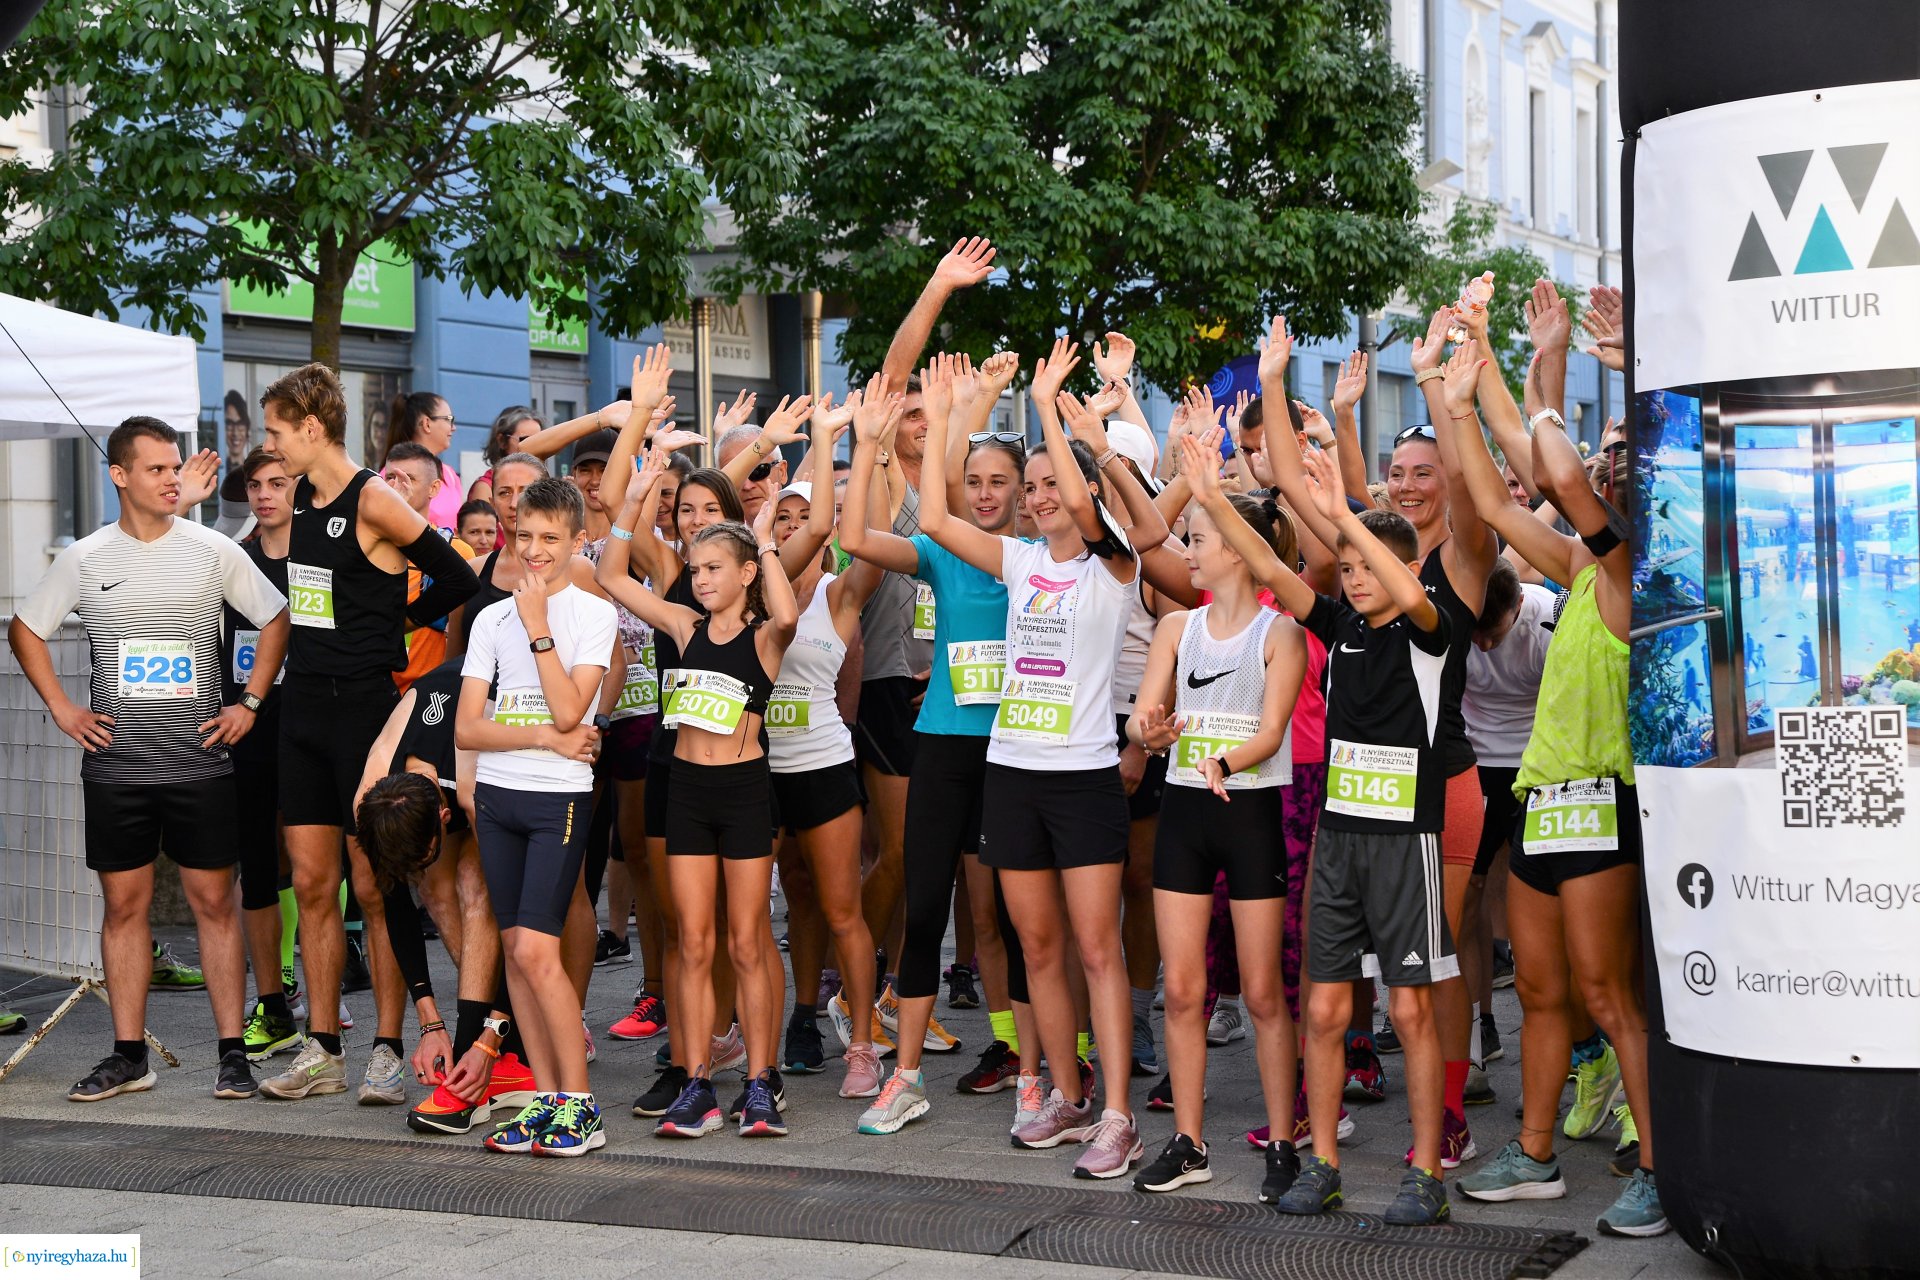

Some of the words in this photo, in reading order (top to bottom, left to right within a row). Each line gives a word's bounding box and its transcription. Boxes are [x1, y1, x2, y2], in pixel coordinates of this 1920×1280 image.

[1771, 292, 1880, 324] WITTUR
[714, 344, 751, 361] ASINO
[122, 656, 193, 684] 528
[676, 693, 730, 721] 5070
[1006, 703, 1058, 729] 5049
[1186, 740, 1240, 765] 514
[1337, 772, 1400, 803] 5146
[1538, 808, 1601, 837] 5144
[1731, 873, 1815, 902] Wittur
[1736, 965, 1920, 998] karrier@wittu
